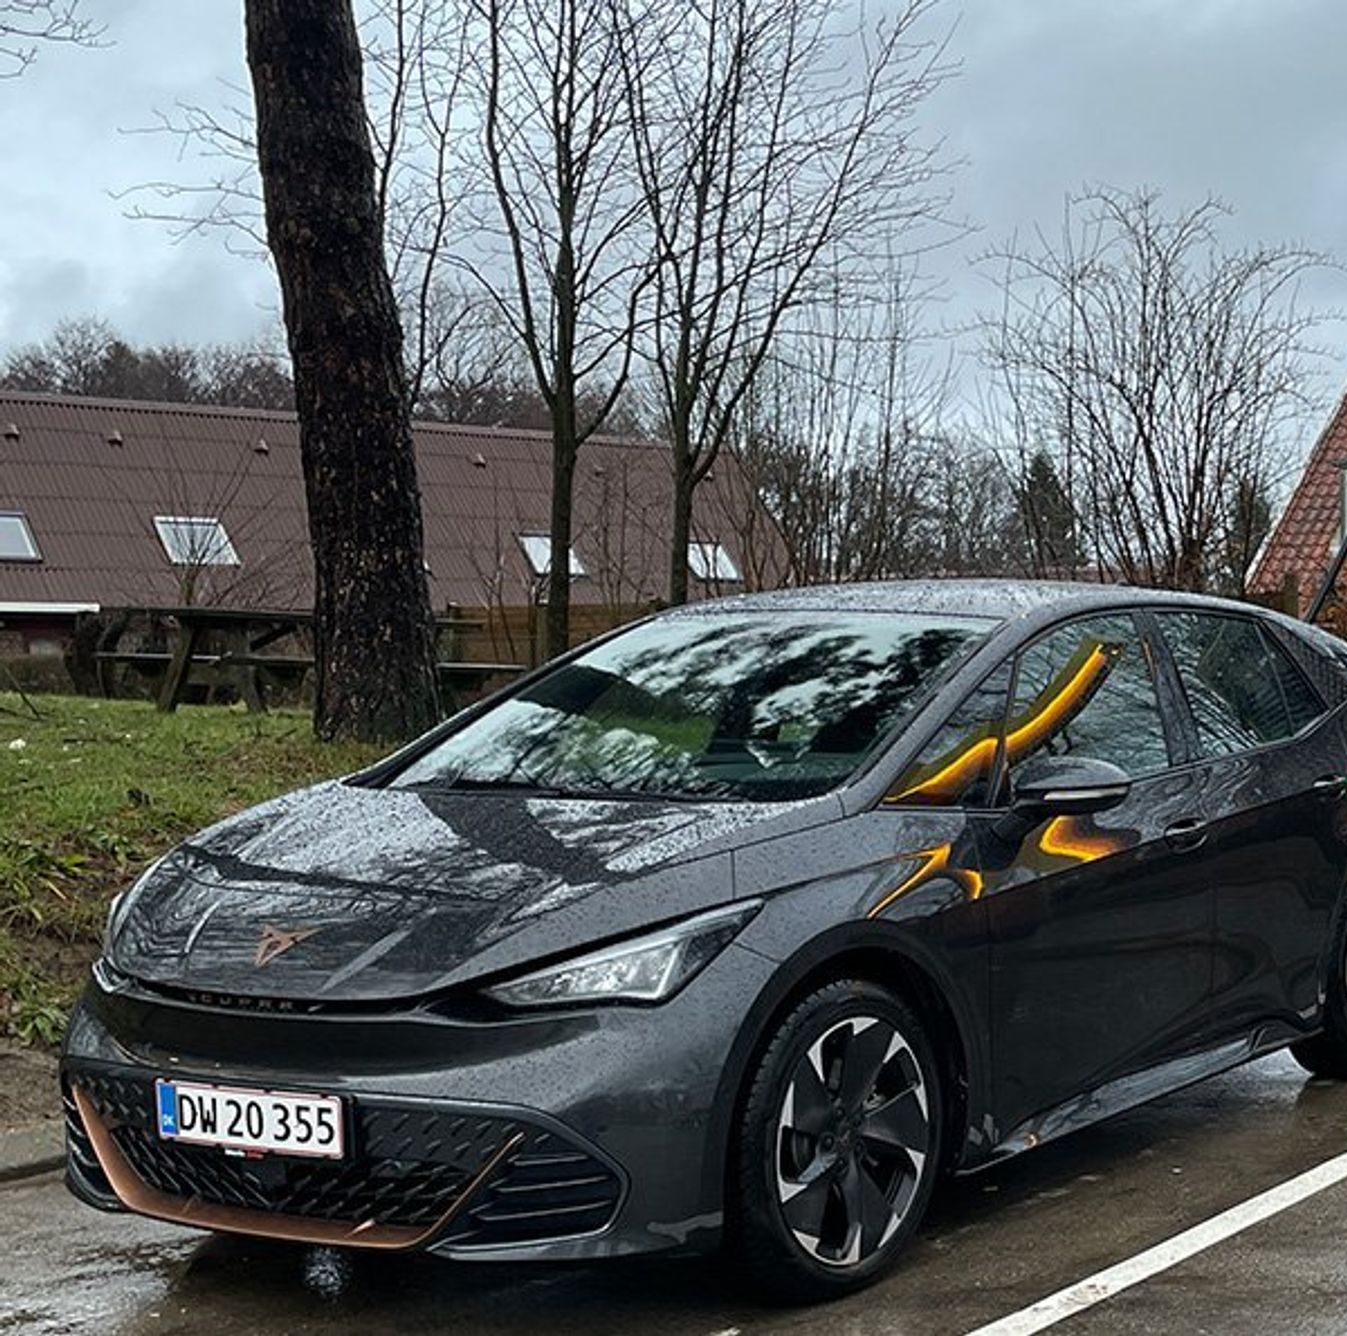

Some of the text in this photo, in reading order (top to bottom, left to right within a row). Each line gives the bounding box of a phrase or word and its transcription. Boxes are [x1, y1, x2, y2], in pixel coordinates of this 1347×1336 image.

[179, 1094, 334, 1145] DW 20 355
